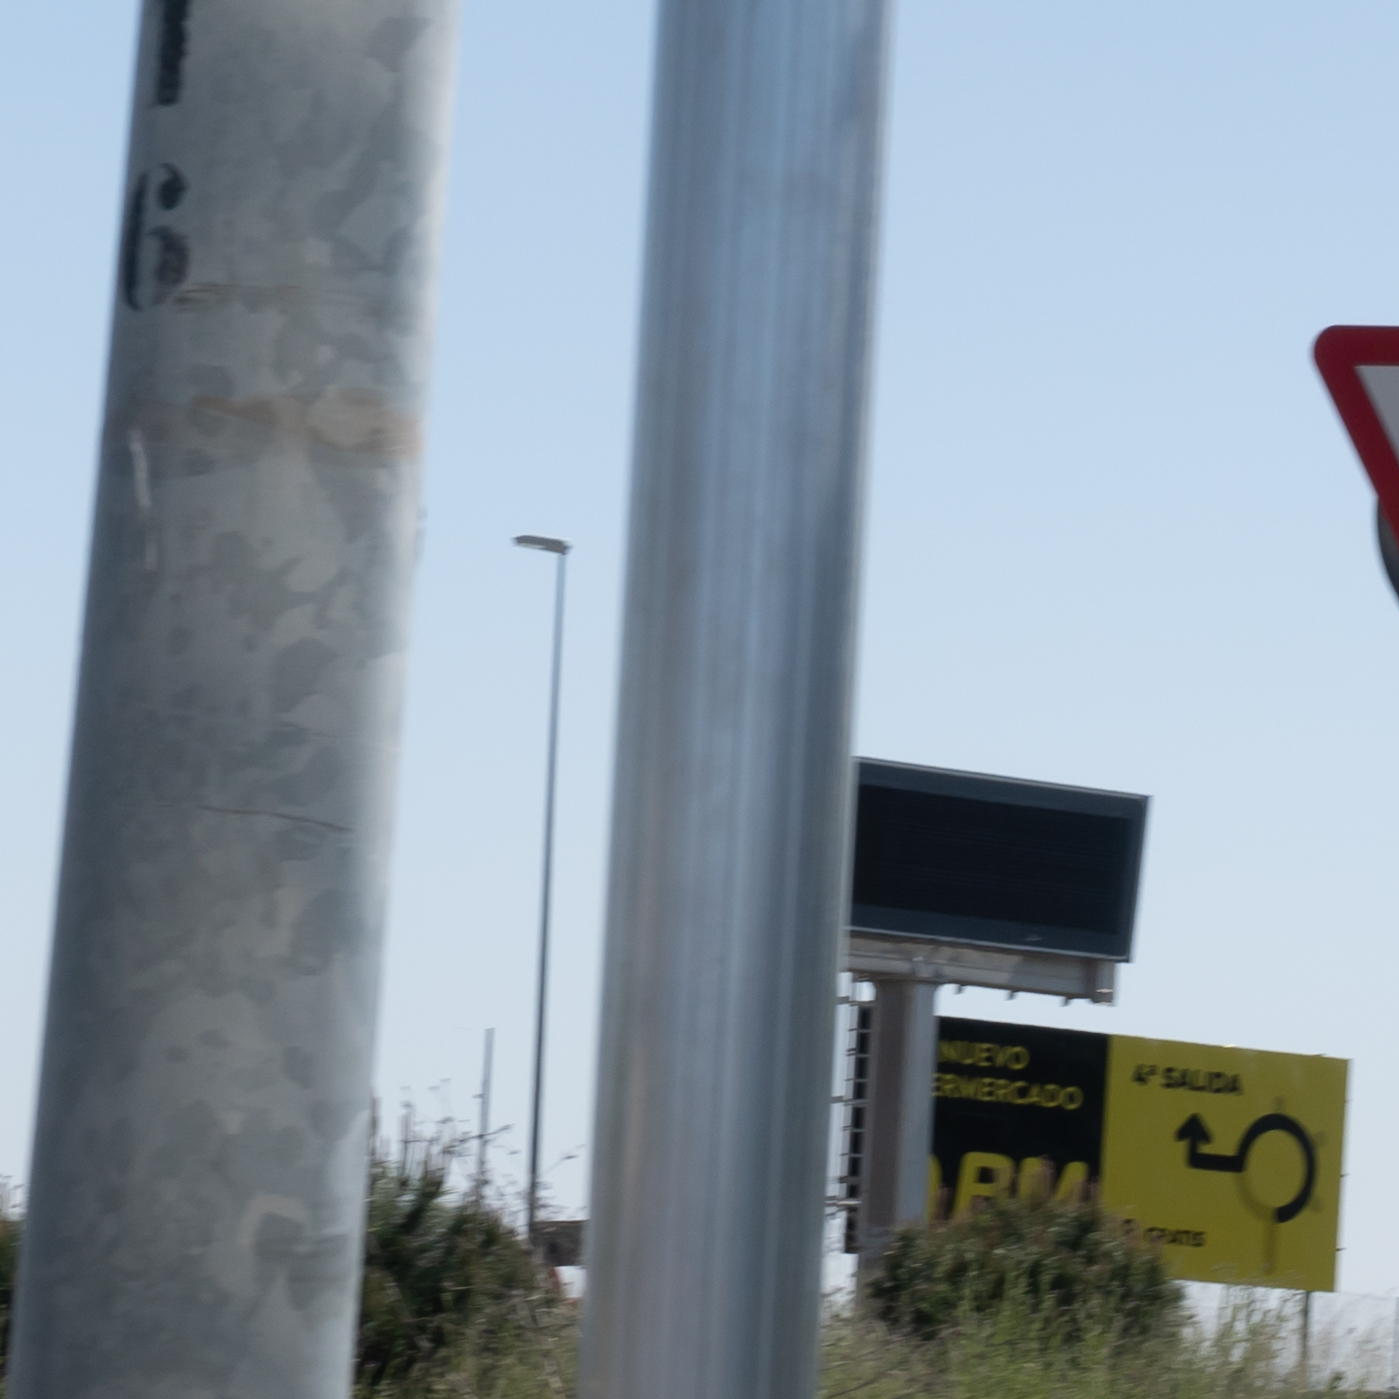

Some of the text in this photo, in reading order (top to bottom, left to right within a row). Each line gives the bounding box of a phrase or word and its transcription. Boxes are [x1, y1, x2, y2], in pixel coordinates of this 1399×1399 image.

[938, 1040, 1031, 1071] NUEVO
[932, 1072, 1084, 1110] ERMERCADO
[1161, 1066, 1245, 1096] SALIDA
